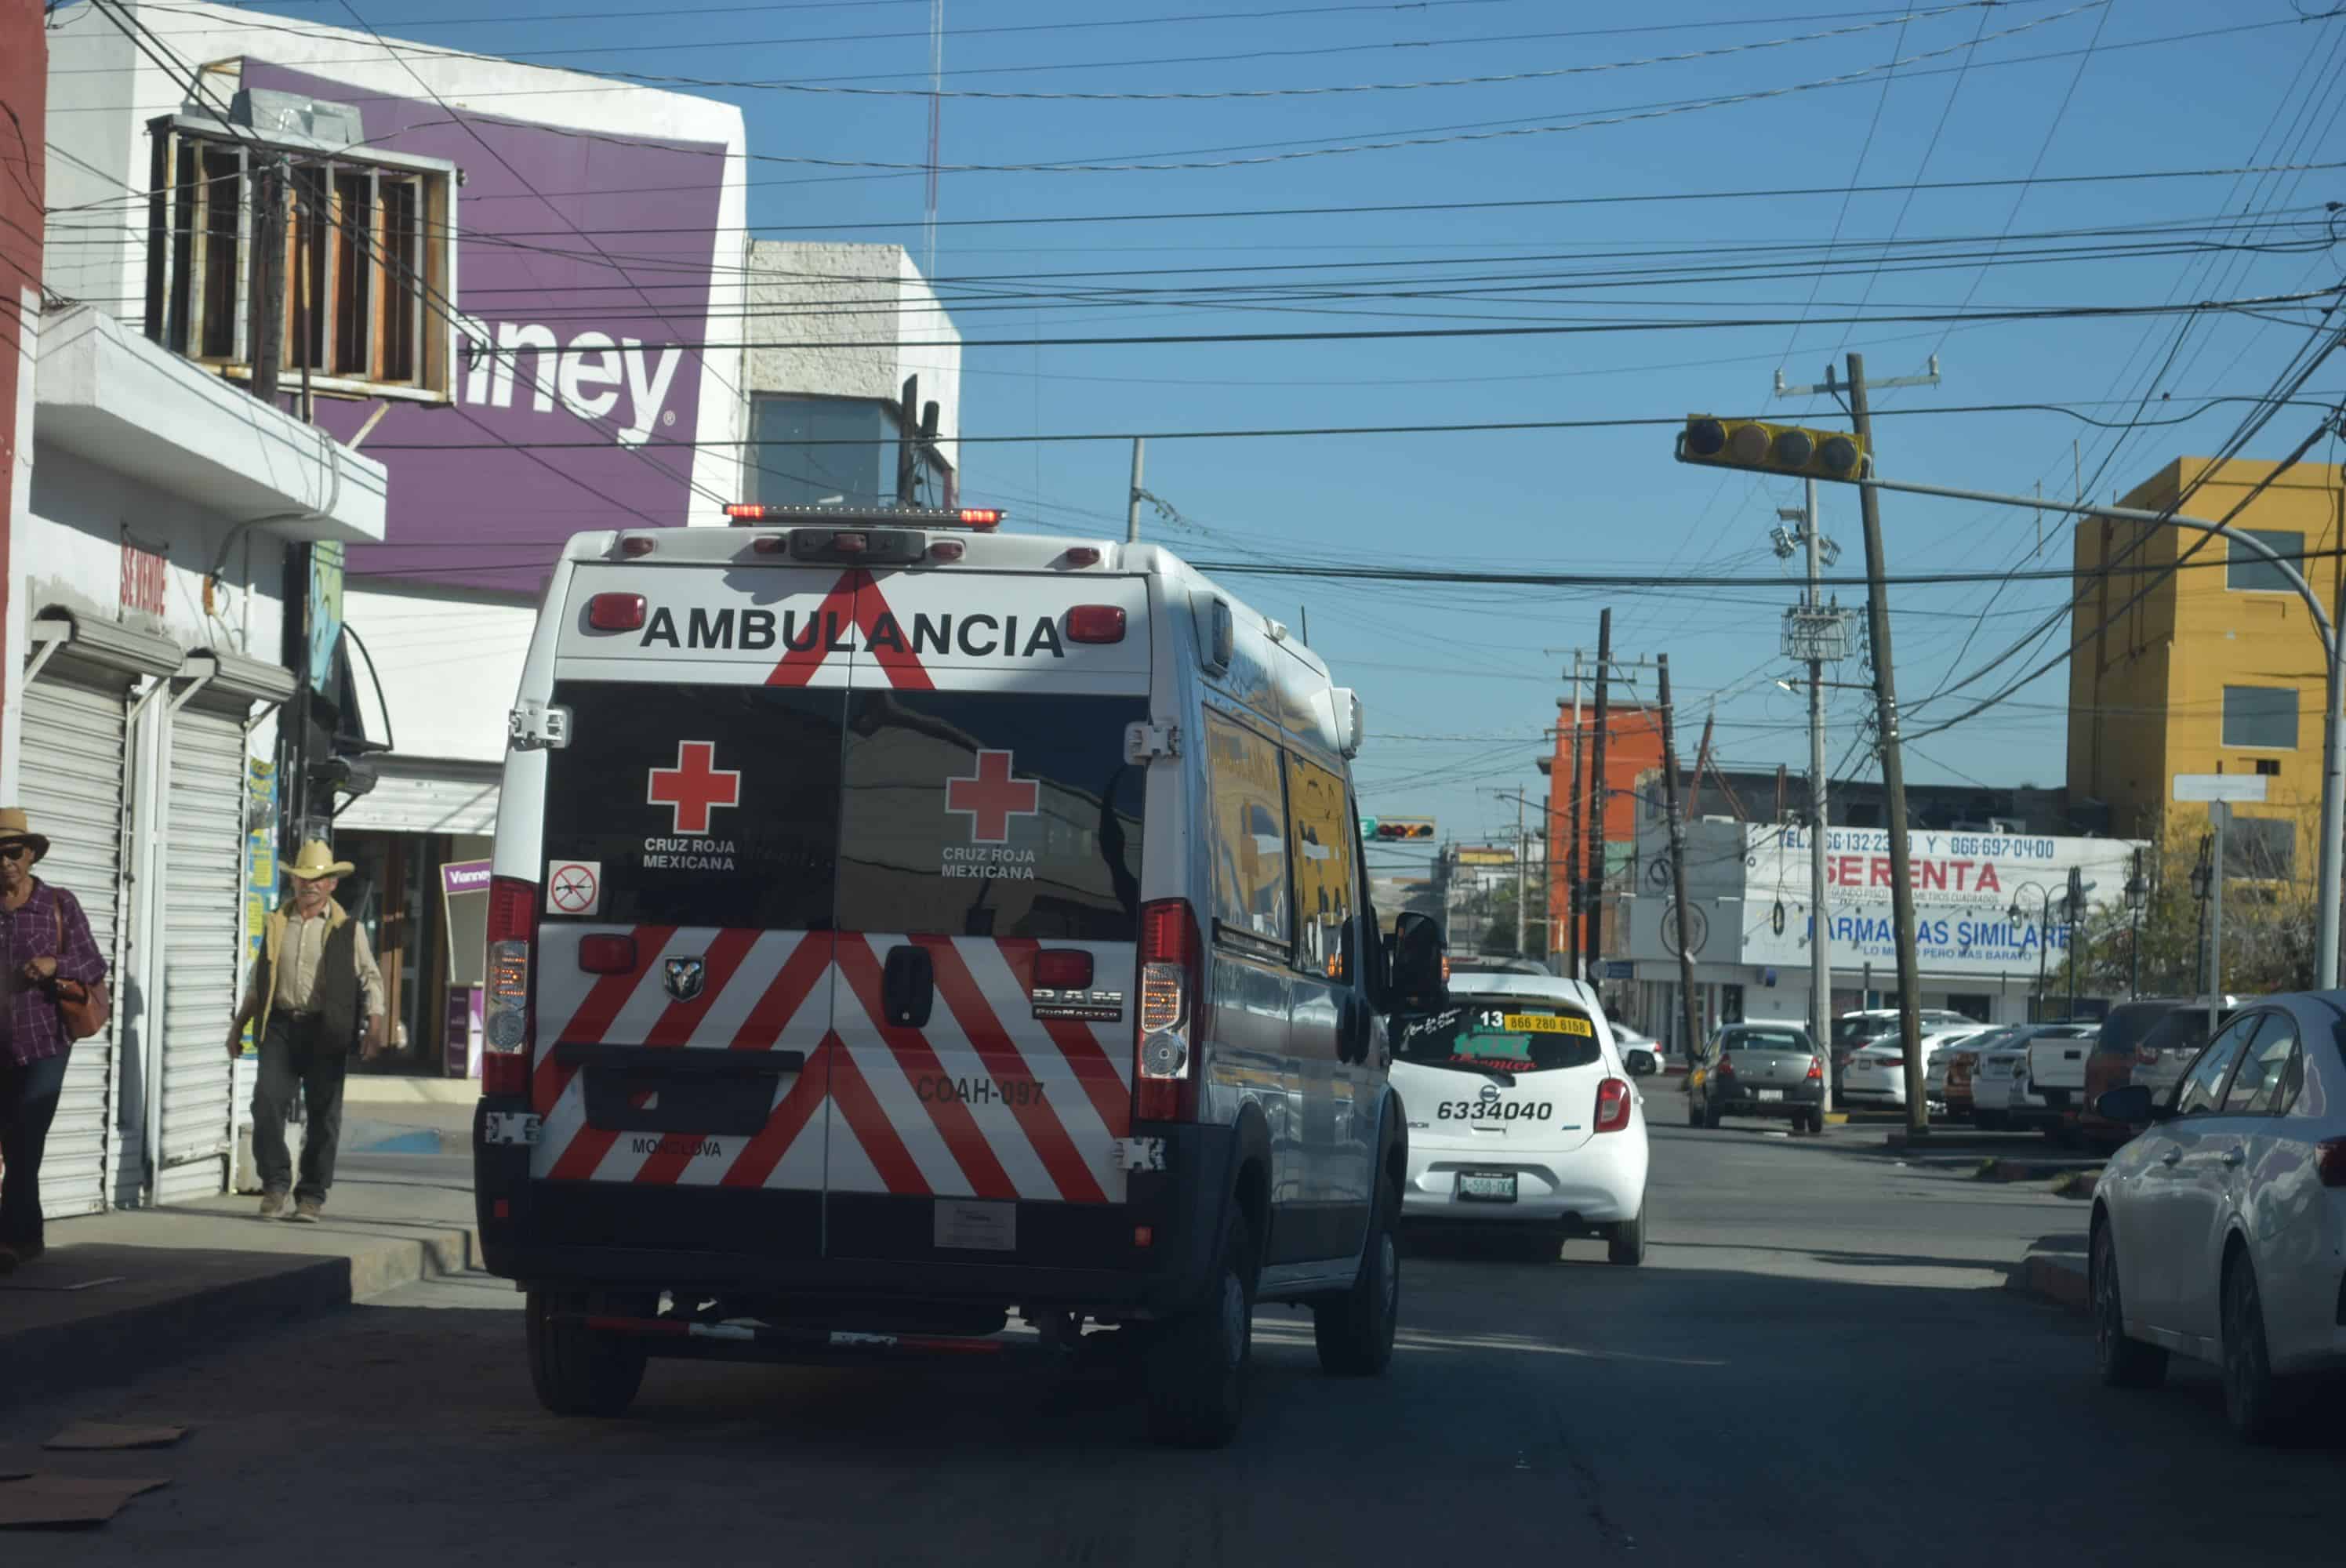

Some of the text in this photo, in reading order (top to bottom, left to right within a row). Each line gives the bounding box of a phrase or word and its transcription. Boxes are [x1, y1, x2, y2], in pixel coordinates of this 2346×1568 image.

[640, 606, 1066, 658] AMBULANCIA
[644, 838, 735, 855] CRUZ ROJA
[1927, 837, 1937, 854] Y
[643, 855, 735, 871] MEXICANA
[942, 848, 1035, 863] CRUZ ROJA
[942, 863, 1034, 880] MEXICANA
[1807, 916, 1948, 944] RMAAS
[1480, 1011, 1503, 1027] 13
[1536, 1018, 1556, 1030] 280
[916, 1076, 1045, 1106] COAH-097
[1436, 1102, 1552, 1120] 6334040
